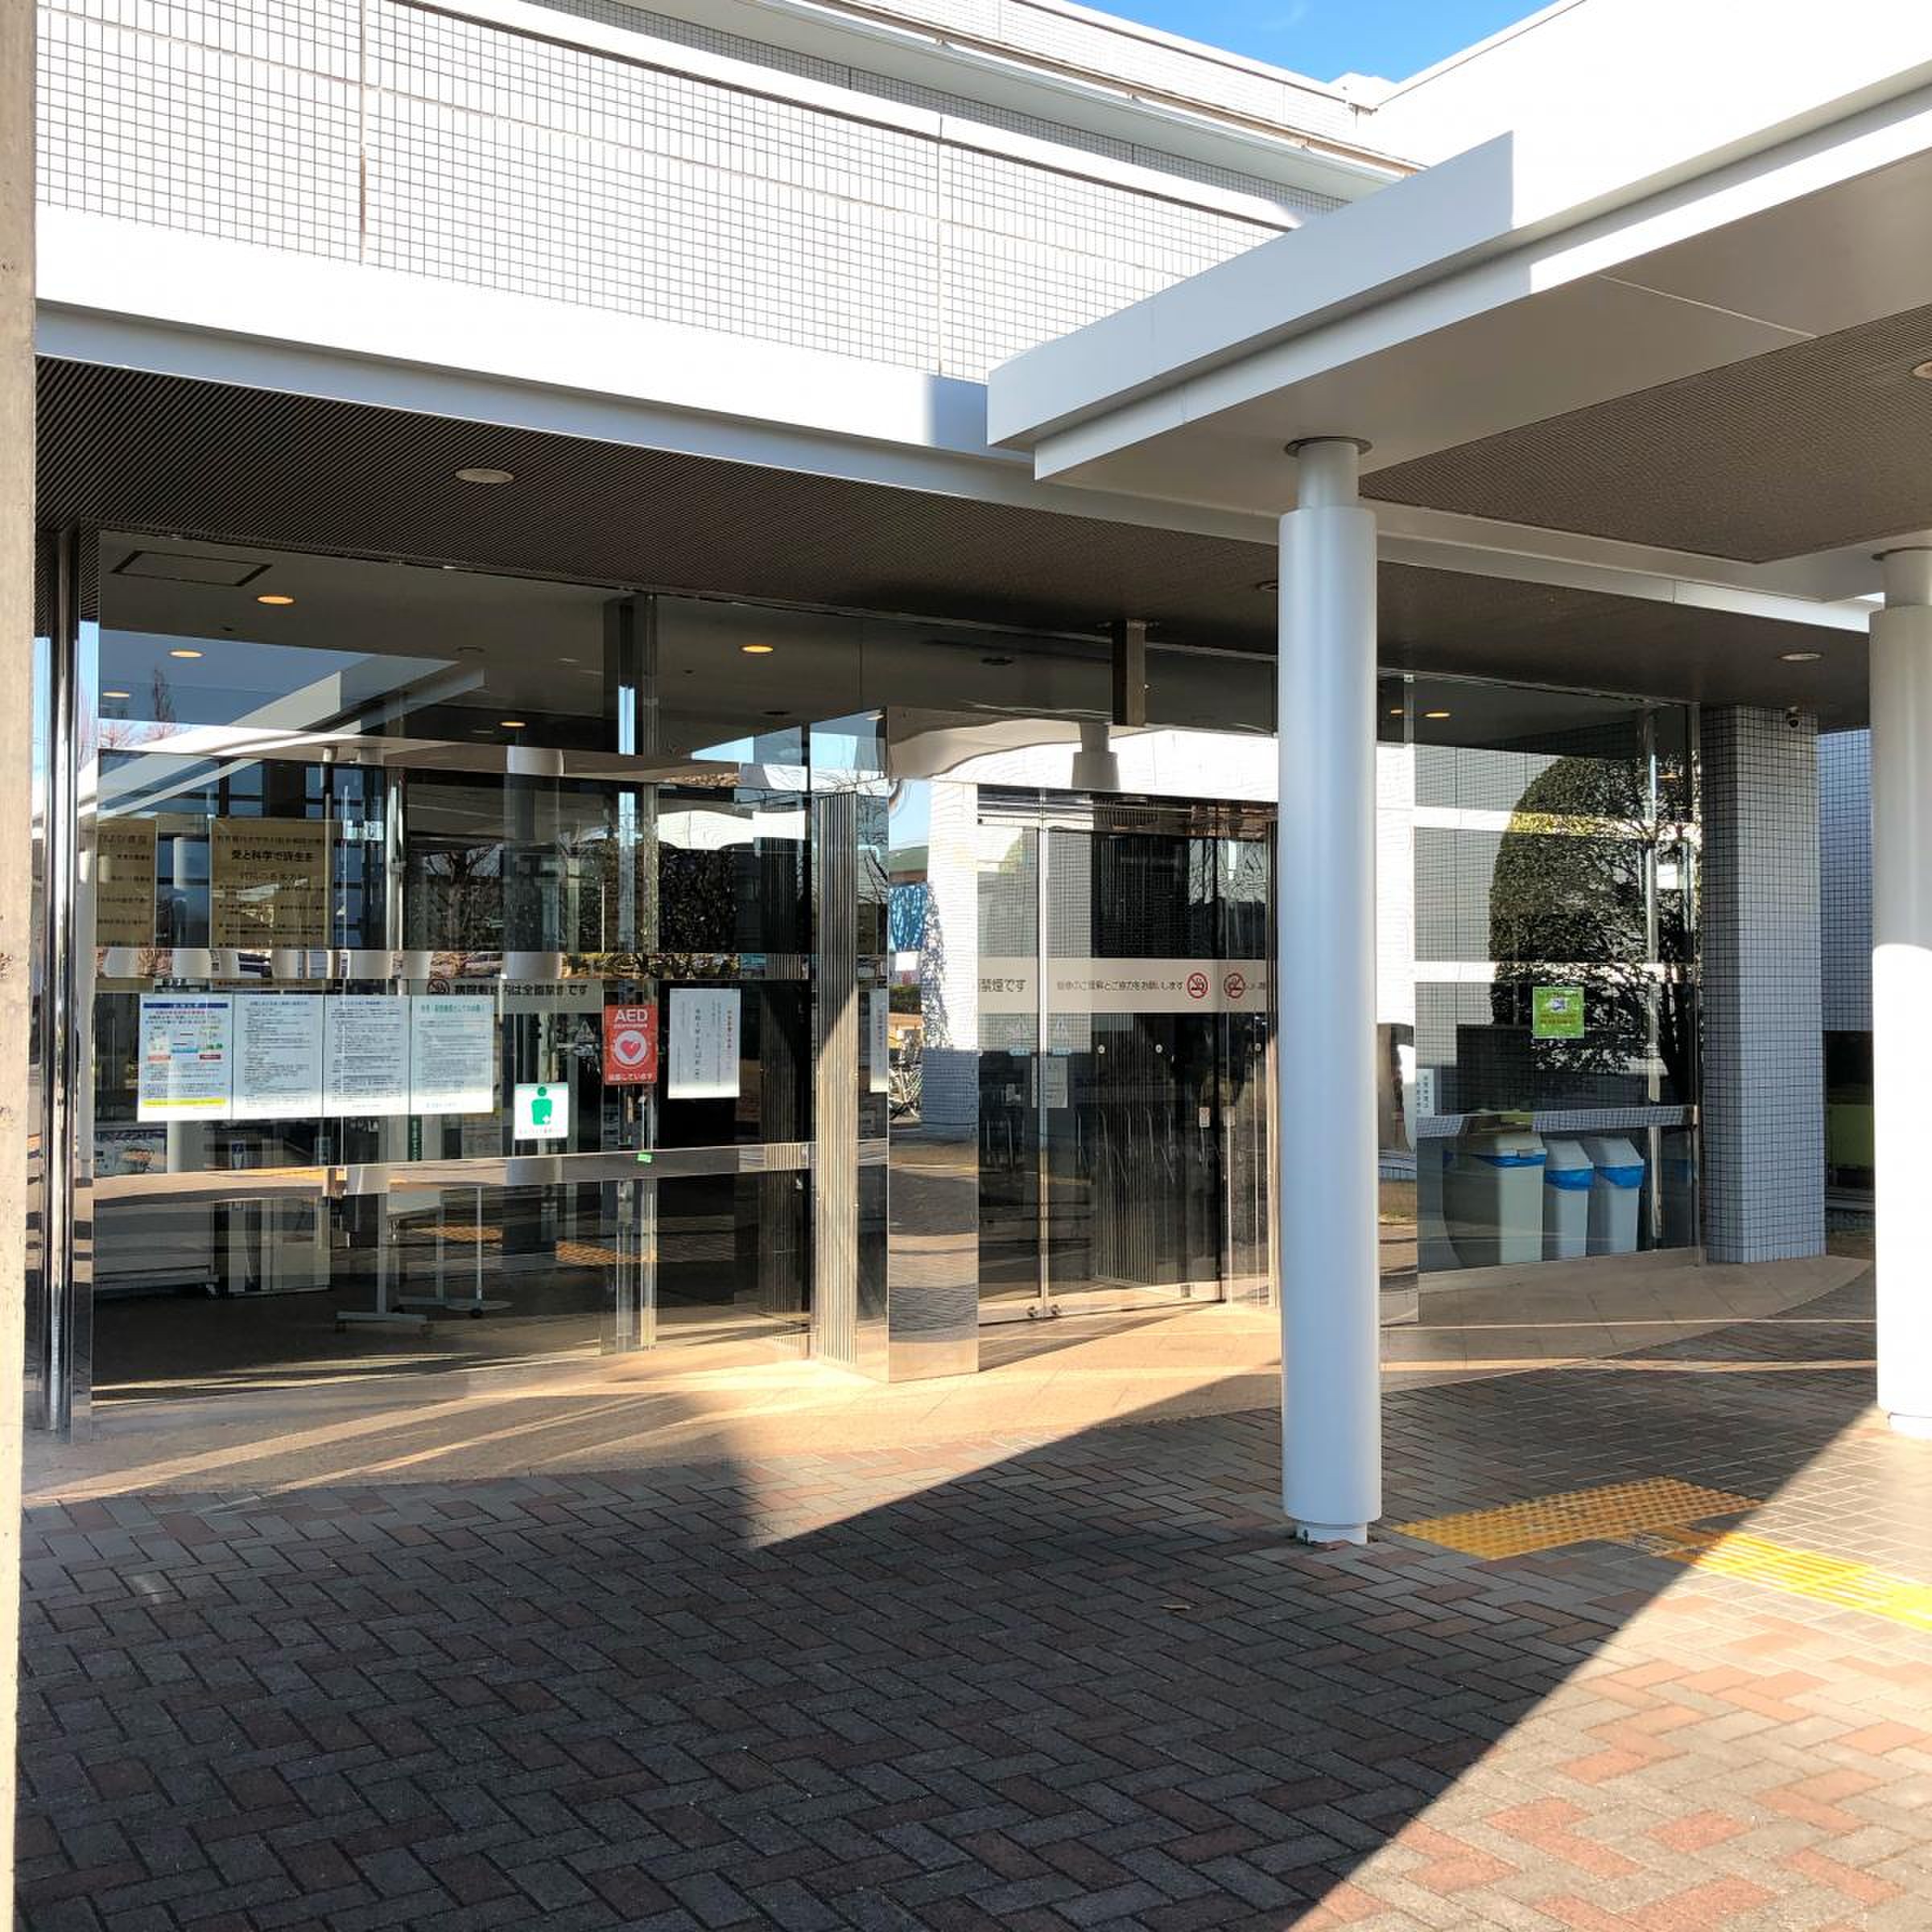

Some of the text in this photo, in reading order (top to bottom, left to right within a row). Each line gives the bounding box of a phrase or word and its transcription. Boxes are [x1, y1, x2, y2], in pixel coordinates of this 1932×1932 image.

[977, 978, 1026, 993] 禁煙です
[614, 1008, 648, 1022] AED
